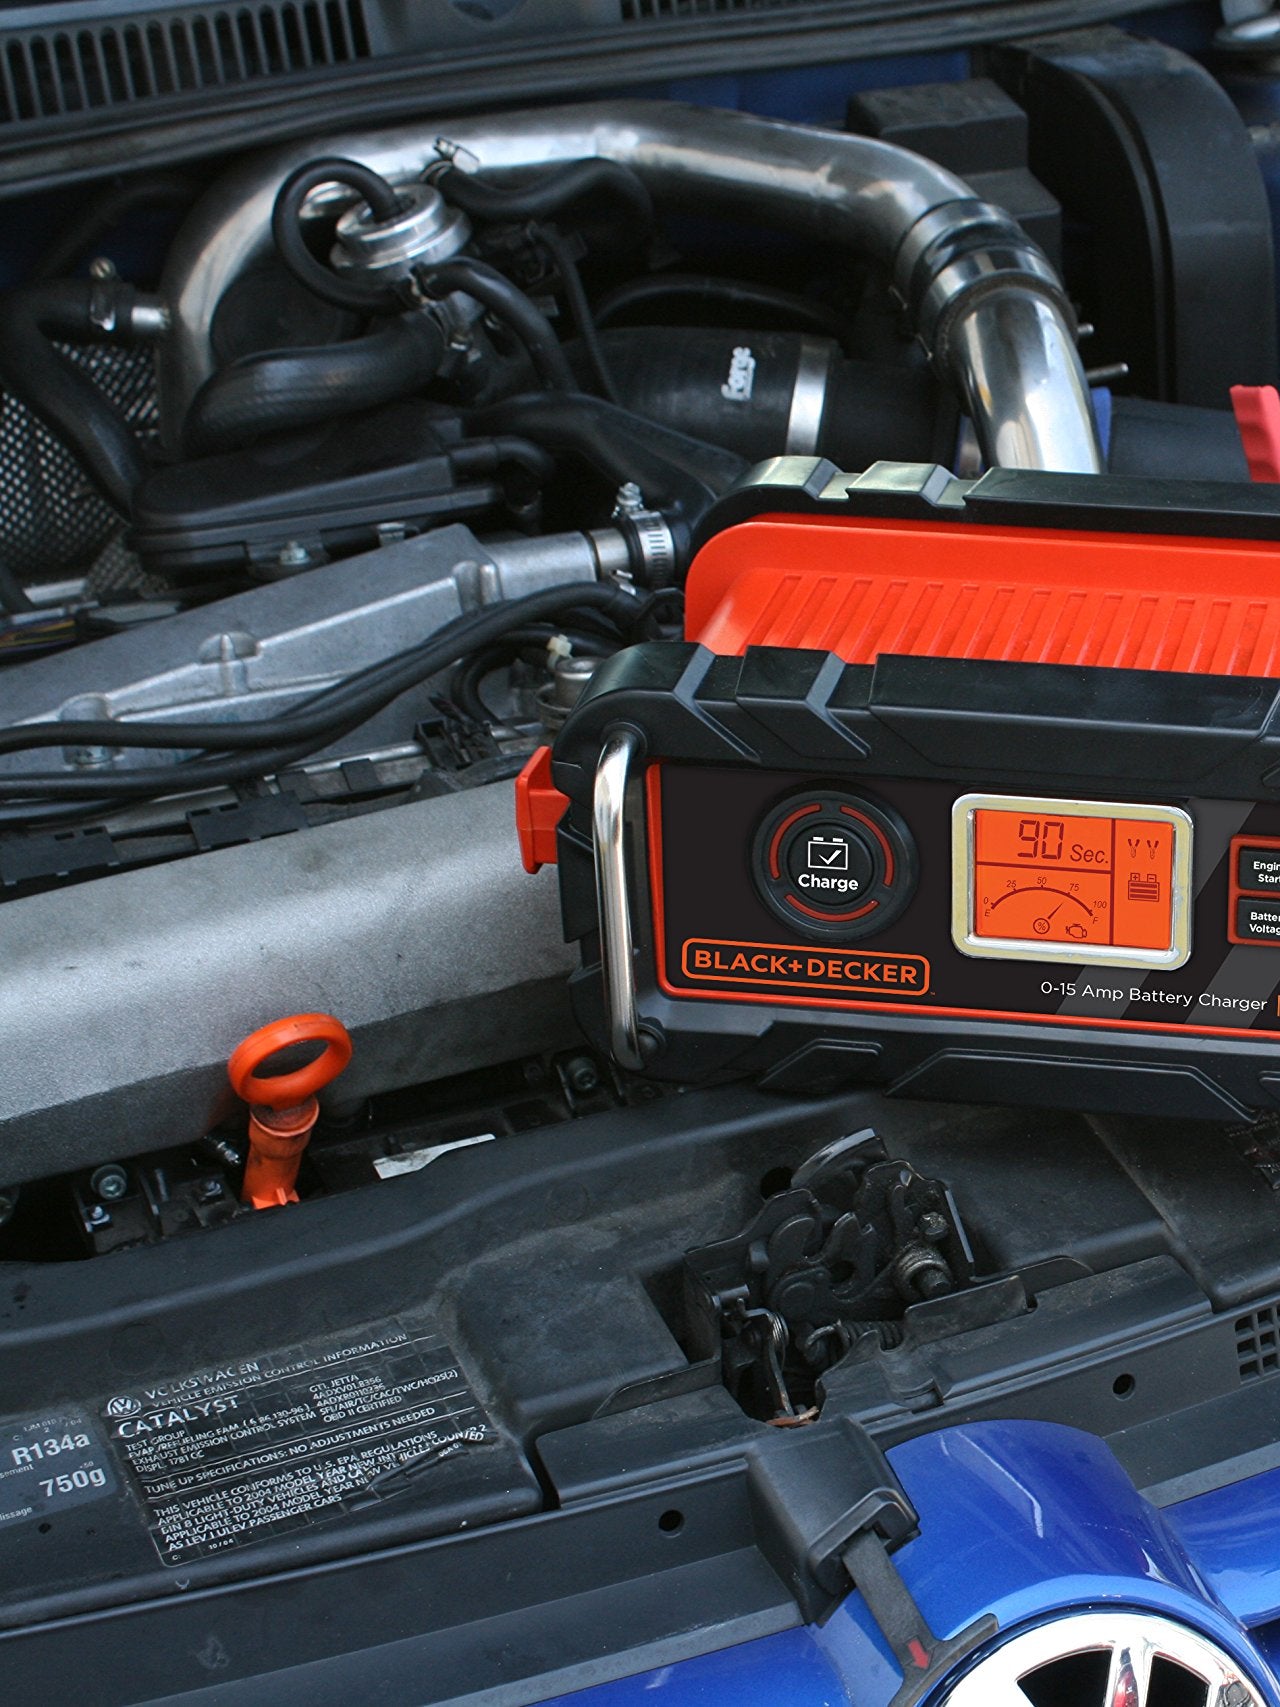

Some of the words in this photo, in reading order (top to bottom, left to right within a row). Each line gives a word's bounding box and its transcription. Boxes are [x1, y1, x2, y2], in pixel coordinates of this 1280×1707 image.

[1017, 819, 1065, 860] 90
[1069, 844, 1109, 864] Sec.
[798, 874, 859, 893] Charge
[1006, 879, 1017, 888] 25
[1036, 876, 1047, 885] 50
[1069, 883, 1080, 892] 75
[984, 909, 990, 918] E
[1092, 900, 1107, 909] 100
[1092, 917, 1099, 925] F
[694, 949, 918, 985] BLACK+DECKER
[1040, 981, 1077, 996] 0-15
[1082, 984, 1123, 1003] Amp
[1129, 987, 1193, 1008] Battery
[1198, 993, 1268, 1012] Charger
[204, 1374, 261, 1396] EMISSION
[264, 1358, 320, 1379] CONTROL
[323, 1333, 408, 1362] INFORMATION
[331, 1374, 359, 1388] JETTA
[118, 1395, 239, 1438] CATALYST
[356, 1395, 402, 1415] CERTIFIED
[12, 1433, 91, 1465] R134a
[126, 1440, 147, 1453] TEST
[151, 1430, 185, 1445] GROUP
[132, 1449, 178, 1466] EXHAUST
[180, 1436, 228, 1455] EMISSION
[230, 1422, 276, 1440] CONTROL
[277, 1411, 316, 1430] SYSTEM
[144, 1481, 177, 1494] TUNE
[178, 1475, 194, 1486] UP
[196, 1449, 288, 1483] SPECIFICATIONS:
[289, 1444, 308, 1456] NO
[309, 1420, 390, 1450] ADJUSTMENTS
[392, 1407, 436, 1427] NEEDED
[153, 1504, 180, 1518] THIS
[182, 1490, 230, 1509] VEHICLE
[230, 1472, 294, 1495] CONFORMS
[295, 1467, 312, 1478] TO
[360, 1430, 438, 1459] REGULATIONS
[169, 1456, 189, 1466] 1781
[38, 1467, 107, 1497] 750g
[158, 1501, 226, 1526] APPLICABLE
[226, 1496, 243, 1507] TO
[244, 1488, 272, 1502] 2004
[273, 1475, 316, 1494] MODEL
[317, 1466, 348, 1480] YEAR
[349, 1458, 376, 1472] NEW
[165, 1518, 233, 1543] APPLICABLE
[233, 1513, 250, 1524] TO
[253, 1503, 280, 1517] 2004
[281, 1492, 323, 1510] MODEL
[324, 1482, 354, 1496] YEAR
[185, 1519, 193, 1529] 8
[195, 1499, 265, 1525] LIGHT-DUTY
[266, 1484, 319, 1505] VEHICLES
[321, 1474, 347, 1485] AND
[168, 1541, 184, 1552] AS
[185, 1535, 207, 1548] LEV
[215, 1522, 247, 1538] ULEV
[249, 1503, 312, 1527] PASSENGER
[313, 1494, 342, 1509] CARS
